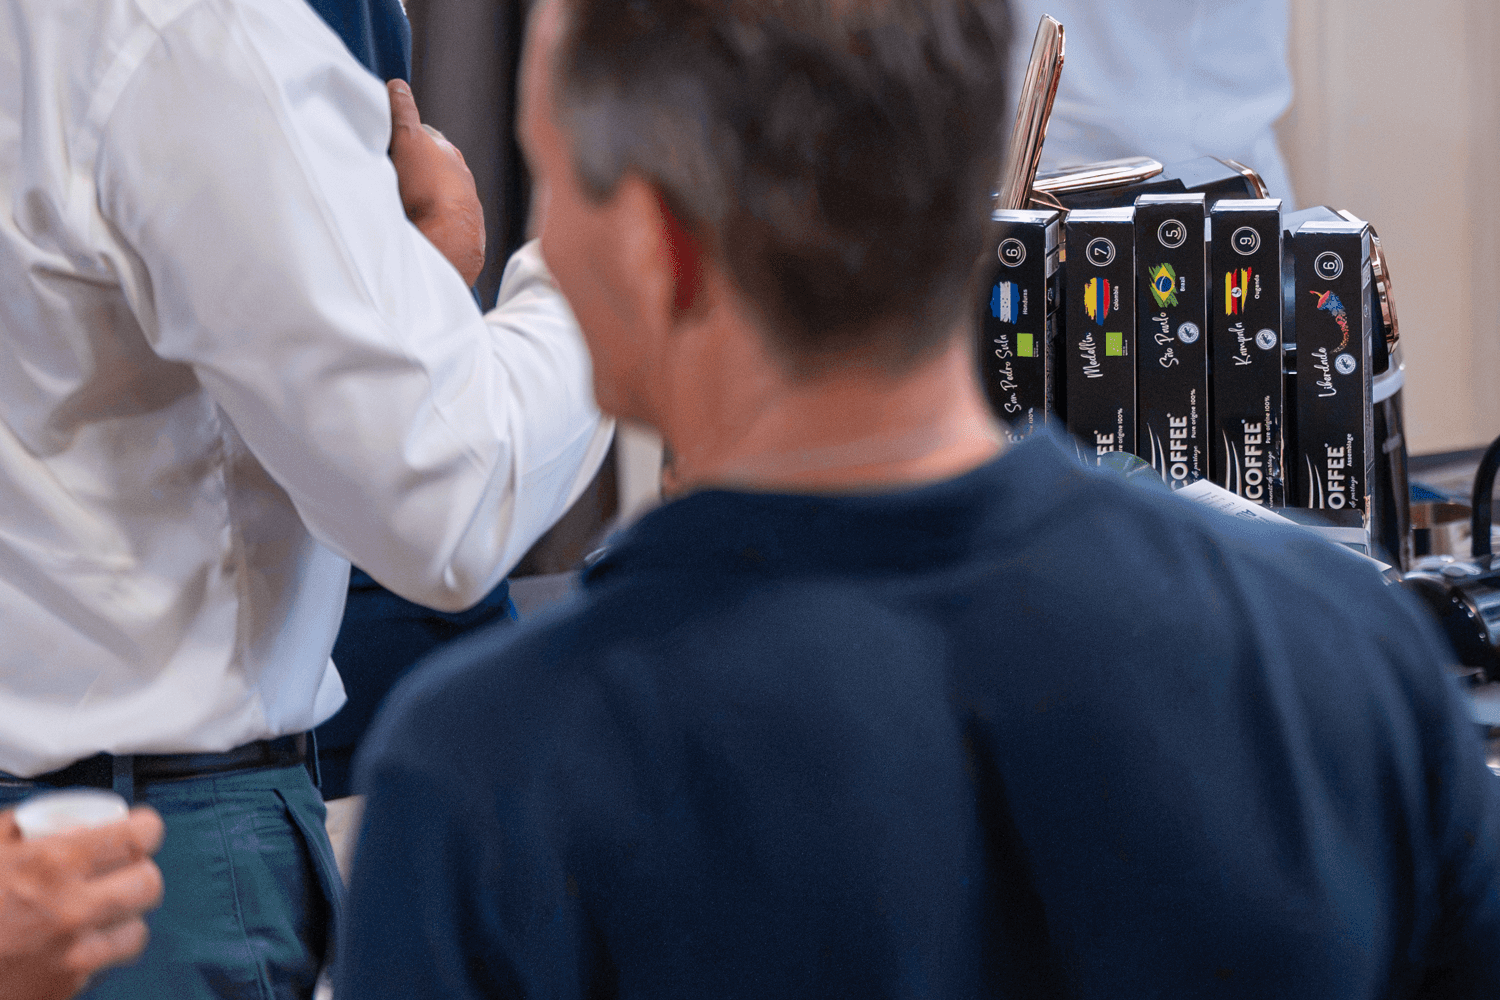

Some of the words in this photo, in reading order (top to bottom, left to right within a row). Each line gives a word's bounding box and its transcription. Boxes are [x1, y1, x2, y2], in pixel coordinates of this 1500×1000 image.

[1166, 230, 1179, 238] 5
[1240, 237, 1252, 245] 9
[1006, 249, 1018, 257] 6
[1095, 248, 1107, 256] 7
[1323, 262, 1335, 270] 6
[1152, 312, 1175, 346] Paulo
[995, 334, 1013, 359] Sula
[1229, 322, 1252, 366] Kampala
[1000, 362, 1018, 391] Pedro
[1312, 347, 1337, 397] Liberdade
[1005, 393, 1022, 413] San
[1245, 422, 1264, 504] COFFEE
[1328, 446, 1346, 510] OFFEE
